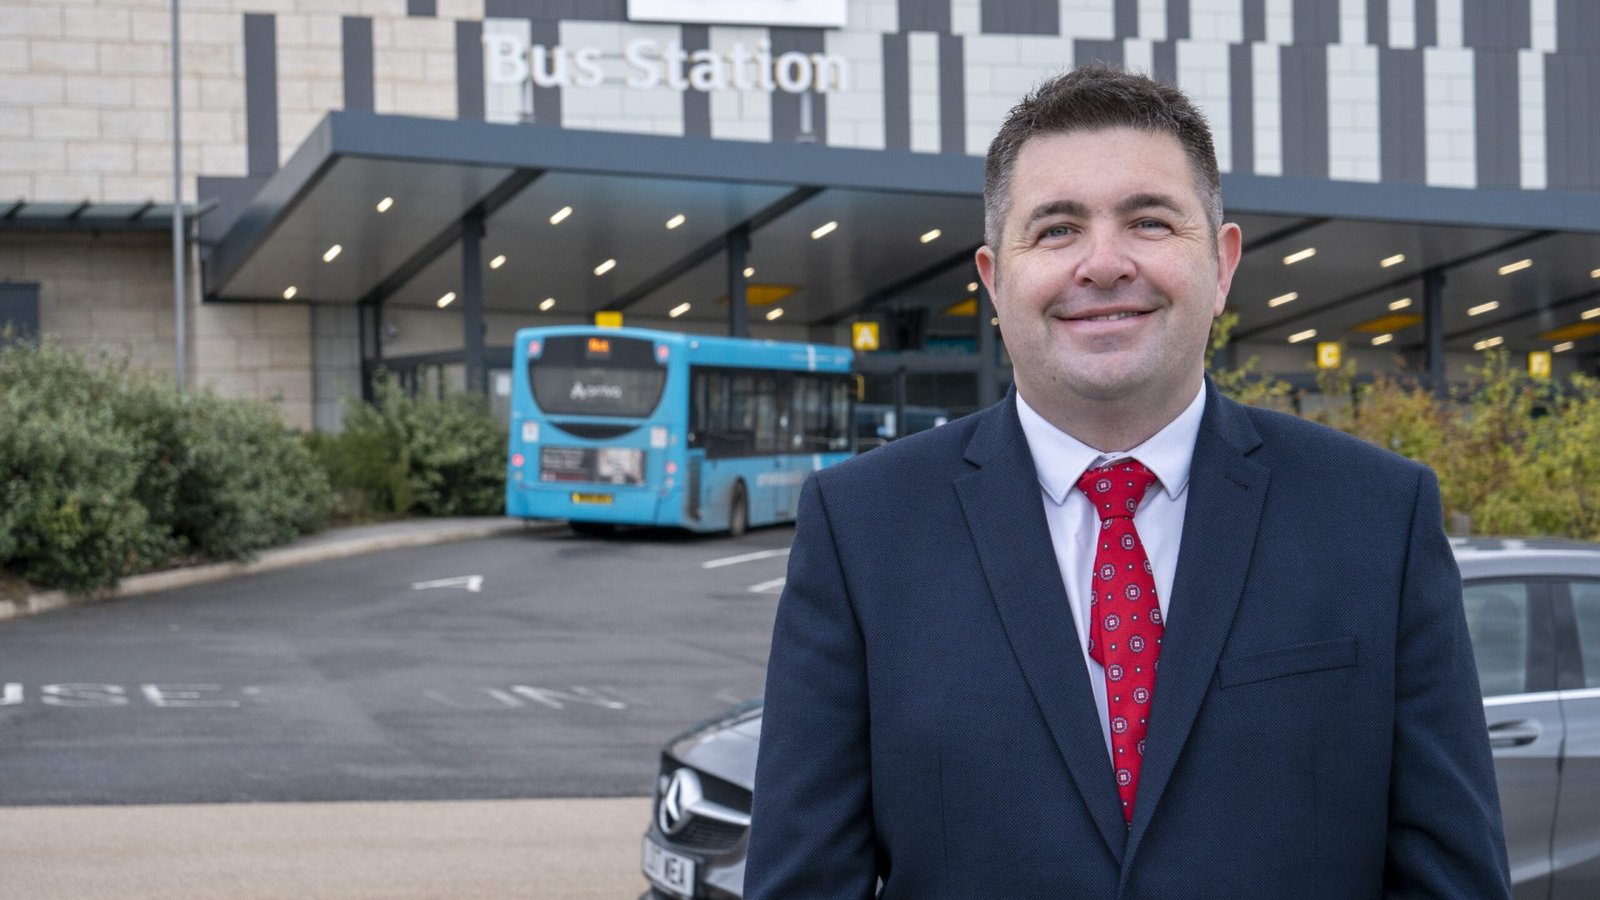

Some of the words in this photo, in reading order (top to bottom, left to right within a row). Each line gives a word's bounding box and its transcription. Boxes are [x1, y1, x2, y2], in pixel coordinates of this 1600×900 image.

[482, 33, 604, 88] Bus
[624, 37, 850, 94] Station
[856, 324, 876, 348] A
